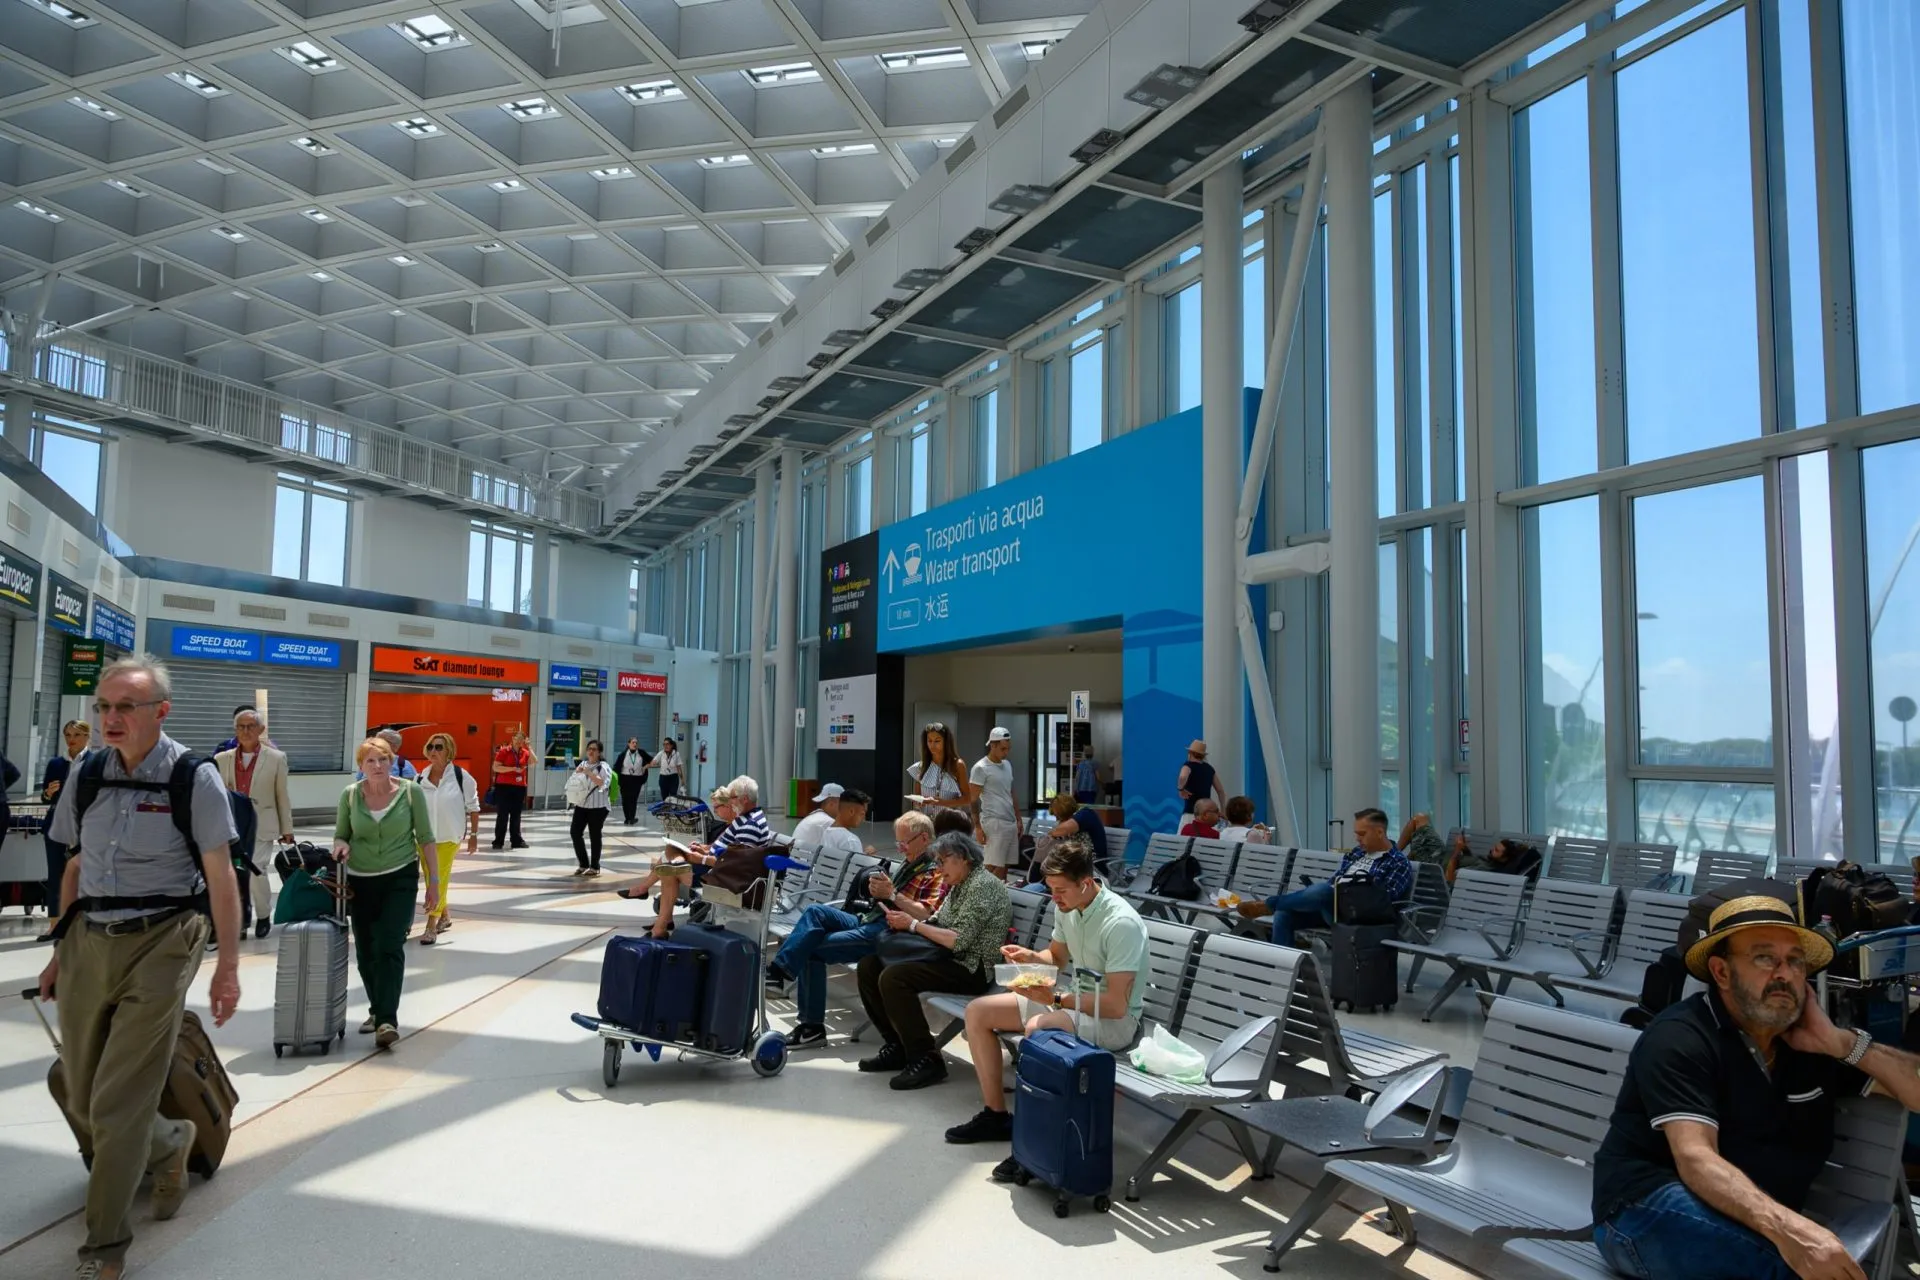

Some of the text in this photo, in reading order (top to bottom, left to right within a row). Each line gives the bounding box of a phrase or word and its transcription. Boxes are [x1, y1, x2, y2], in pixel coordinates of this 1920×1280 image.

[926, 495, 1044, 552] Trasporti via acqua
[0, 555, 33, 595] Europcar
[925, 537, 1021, 585] Water transport
[55, 585, 82, 618] Europcar
[925, 593, 949, 621] 水运
[189, 635, 248, 648] SPEED BOAT
[278, 643, 328, 656] SPEED BOAT
[443, 660, 477, 675] diamond
[480, 664, 505, 678] lounge
